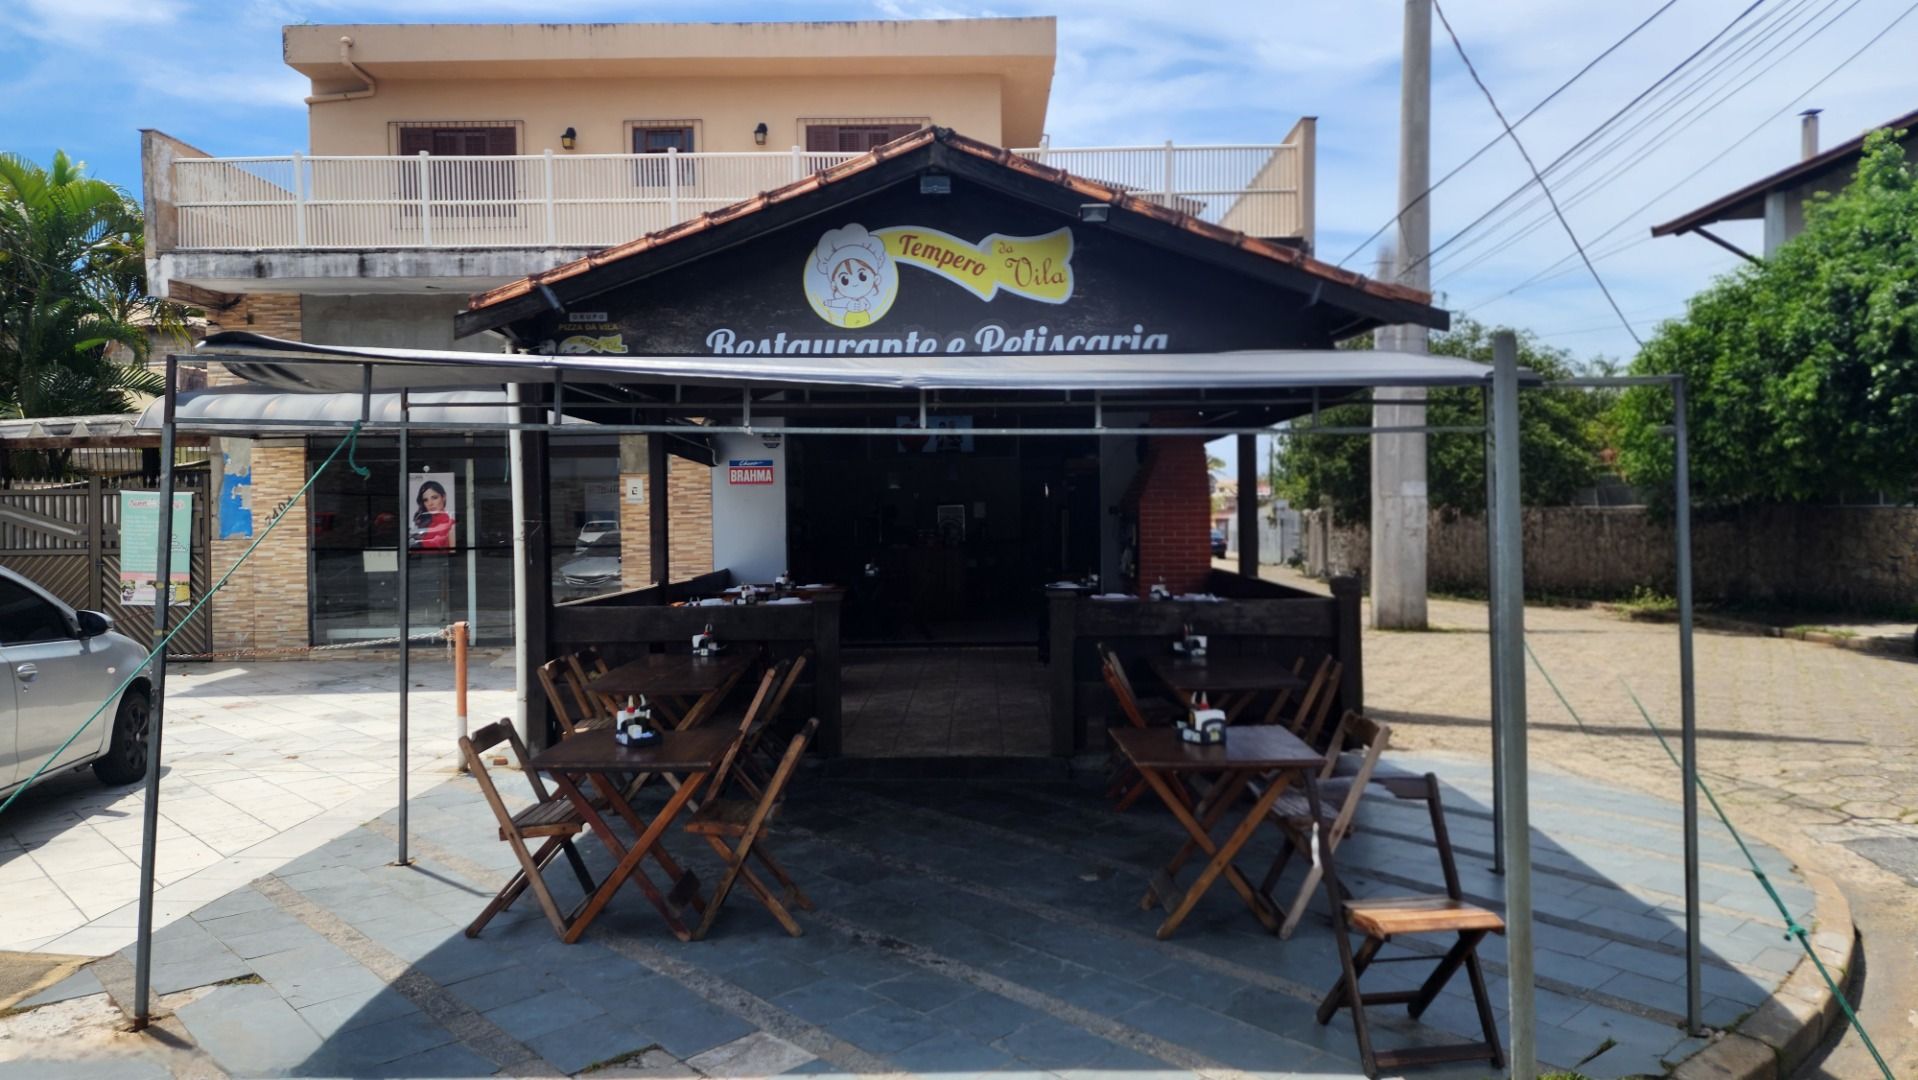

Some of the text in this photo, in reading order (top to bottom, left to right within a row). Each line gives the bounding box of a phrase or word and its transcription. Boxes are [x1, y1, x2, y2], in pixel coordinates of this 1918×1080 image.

[899, 234, 986, 276] Tempero
[1004, 256, 1065, 288] Vila
[730, 469, 772, 482] BRAHMA
